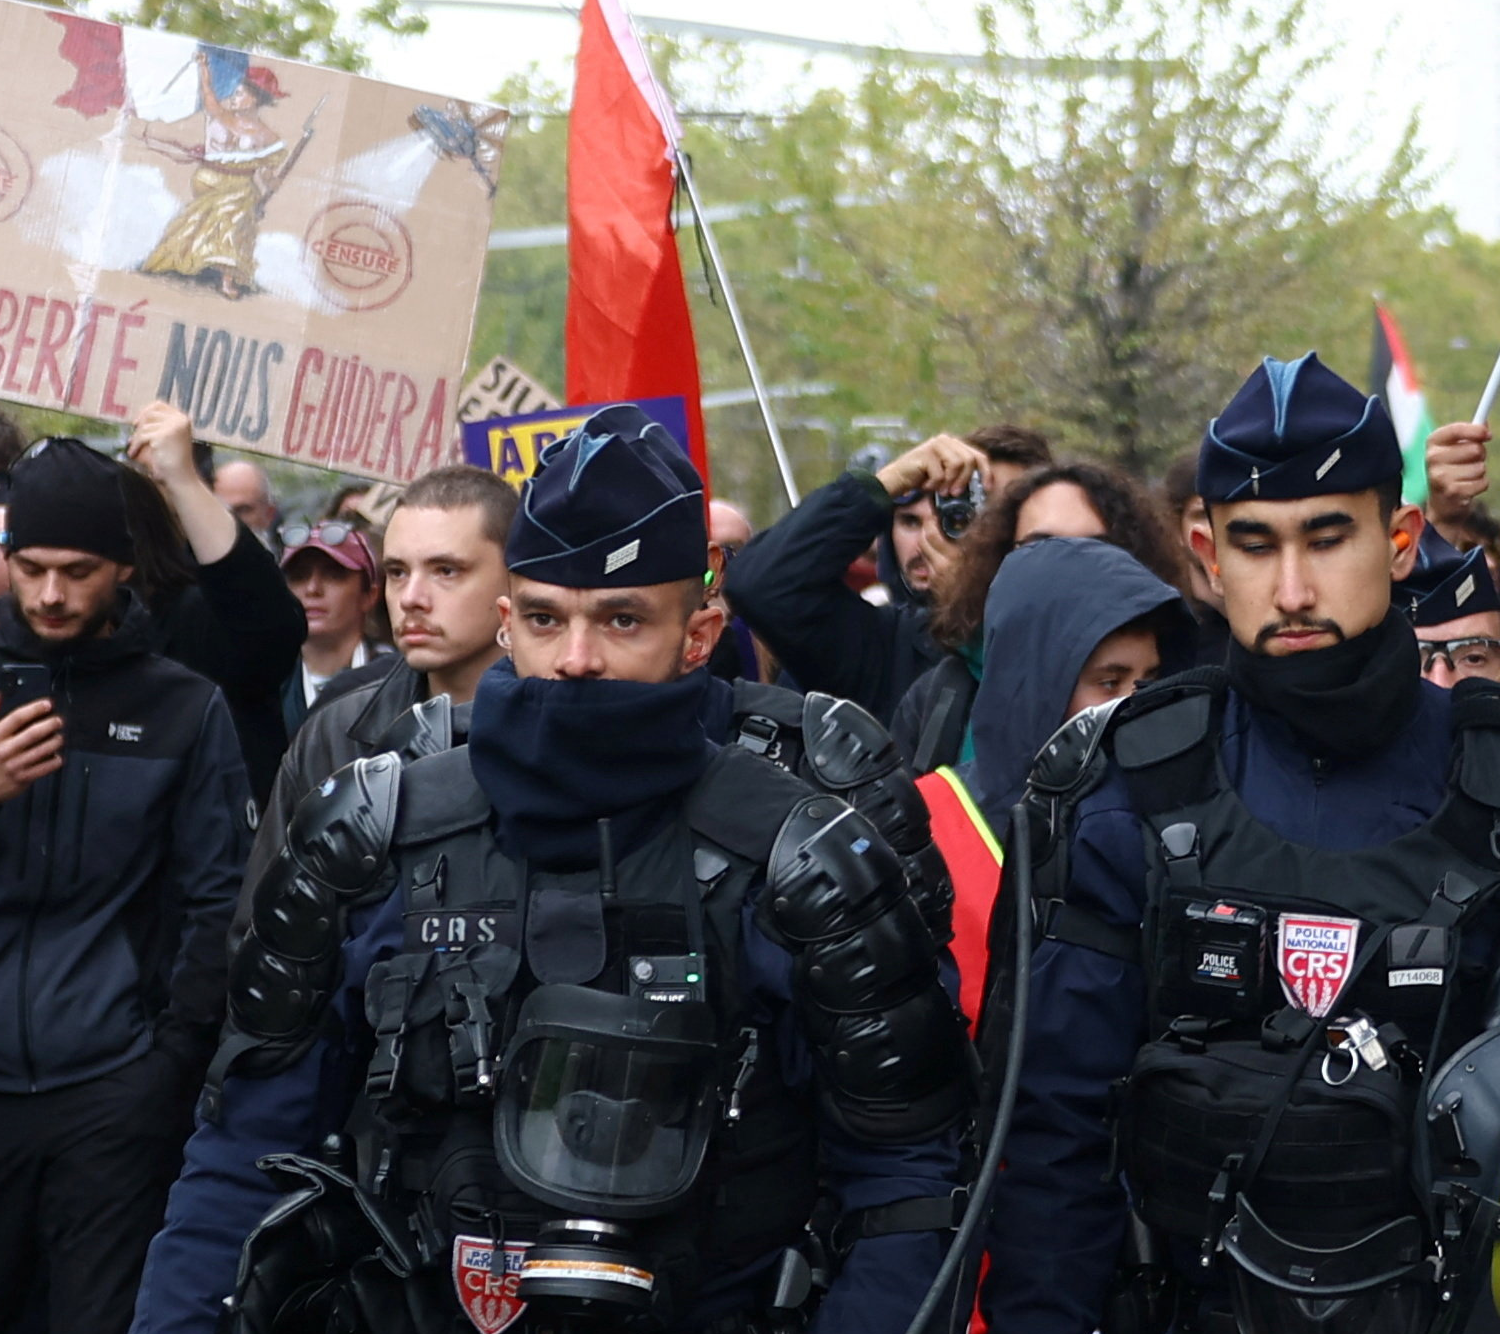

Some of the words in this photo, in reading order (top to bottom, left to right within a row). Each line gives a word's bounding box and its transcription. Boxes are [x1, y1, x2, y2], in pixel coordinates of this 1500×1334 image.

[156, 321, 284, 443] NOUS
[282, 347, 447, 481] GUIDERA
[421, 917, 497, 943] CRS
[1295, 927, 1340, 941] POLICE
[1286, 938, 1347, 952] NATIONALE
[1202, 952, 1235, 968] POLICE
[1287, 951, 1344, 980] CRS
[1392, 971, 1441, 984] 1714068
[471, 1251, 521, 1264] POCE
[464, 1271, 521, 1297] CRS
